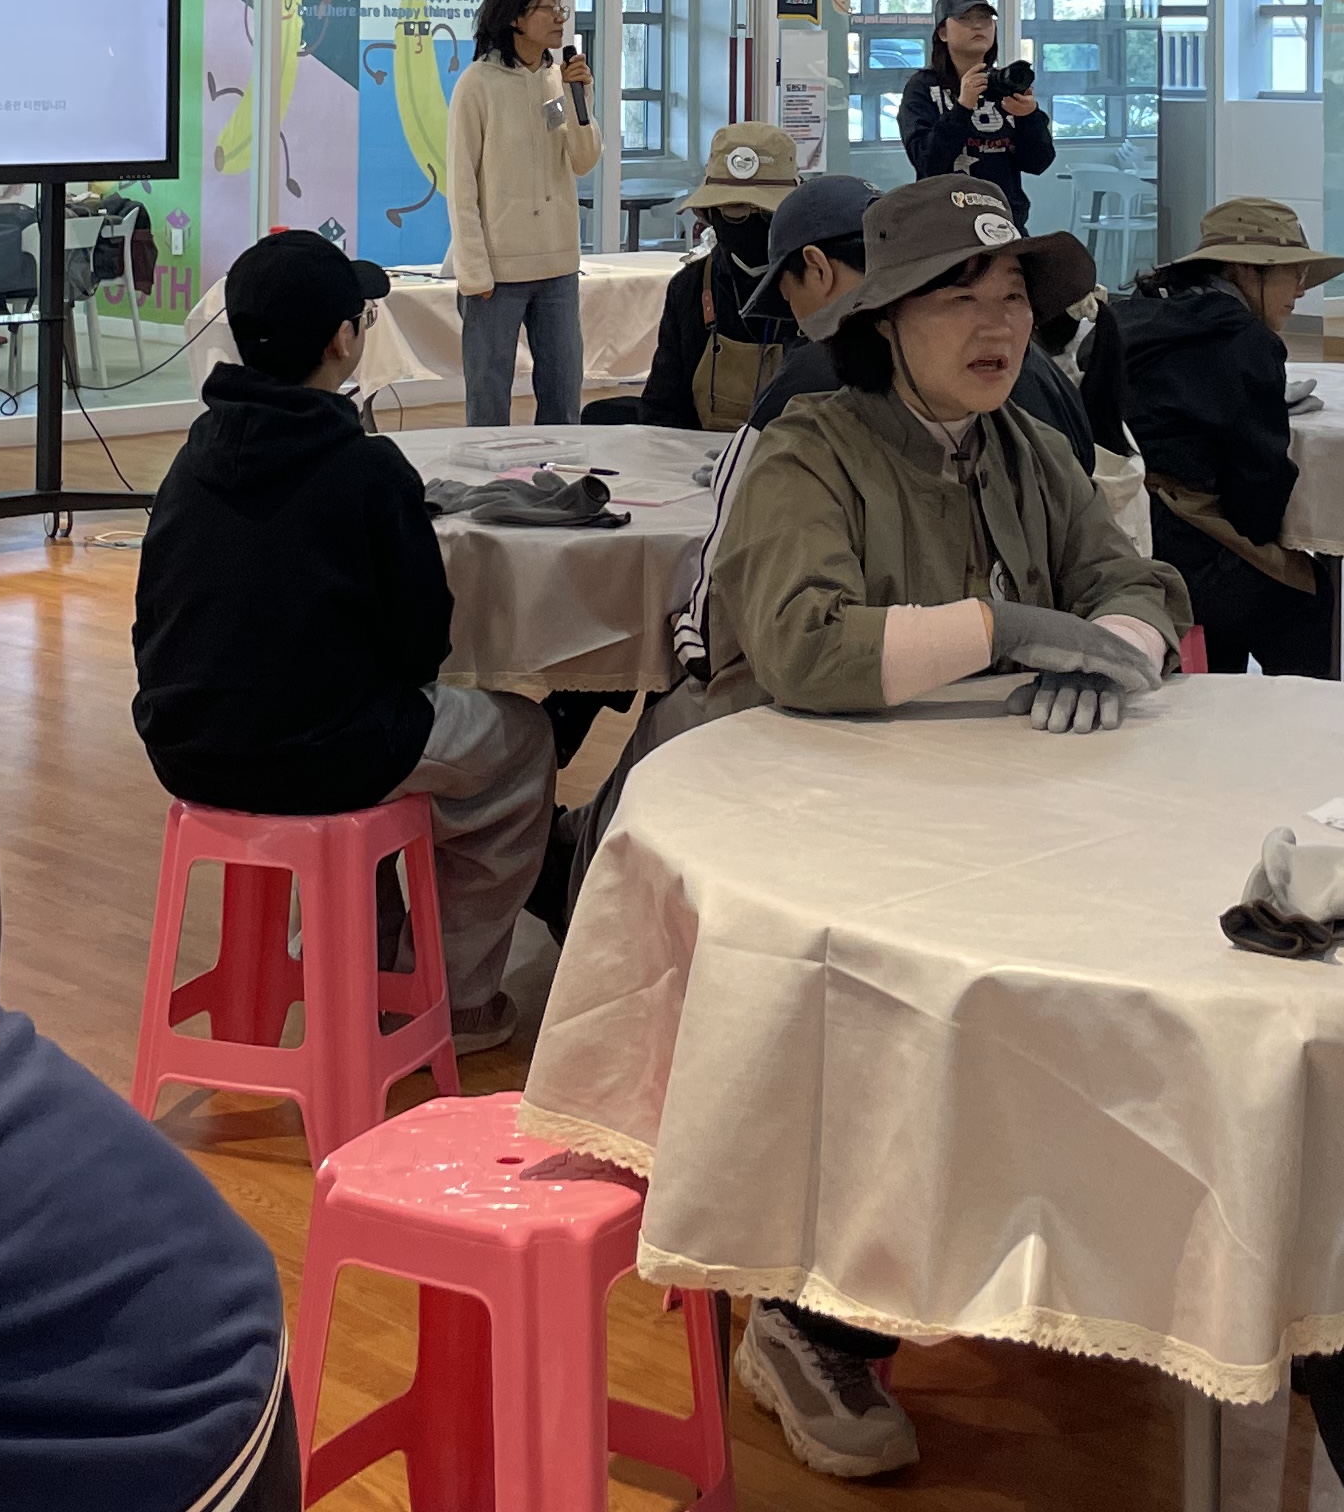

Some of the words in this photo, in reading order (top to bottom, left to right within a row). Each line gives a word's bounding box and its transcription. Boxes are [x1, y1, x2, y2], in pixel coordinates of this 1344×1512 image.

[359, 6, 380, 17] are
[384, 5, 420, 19] happy
[424, 5, 460, 19] things
